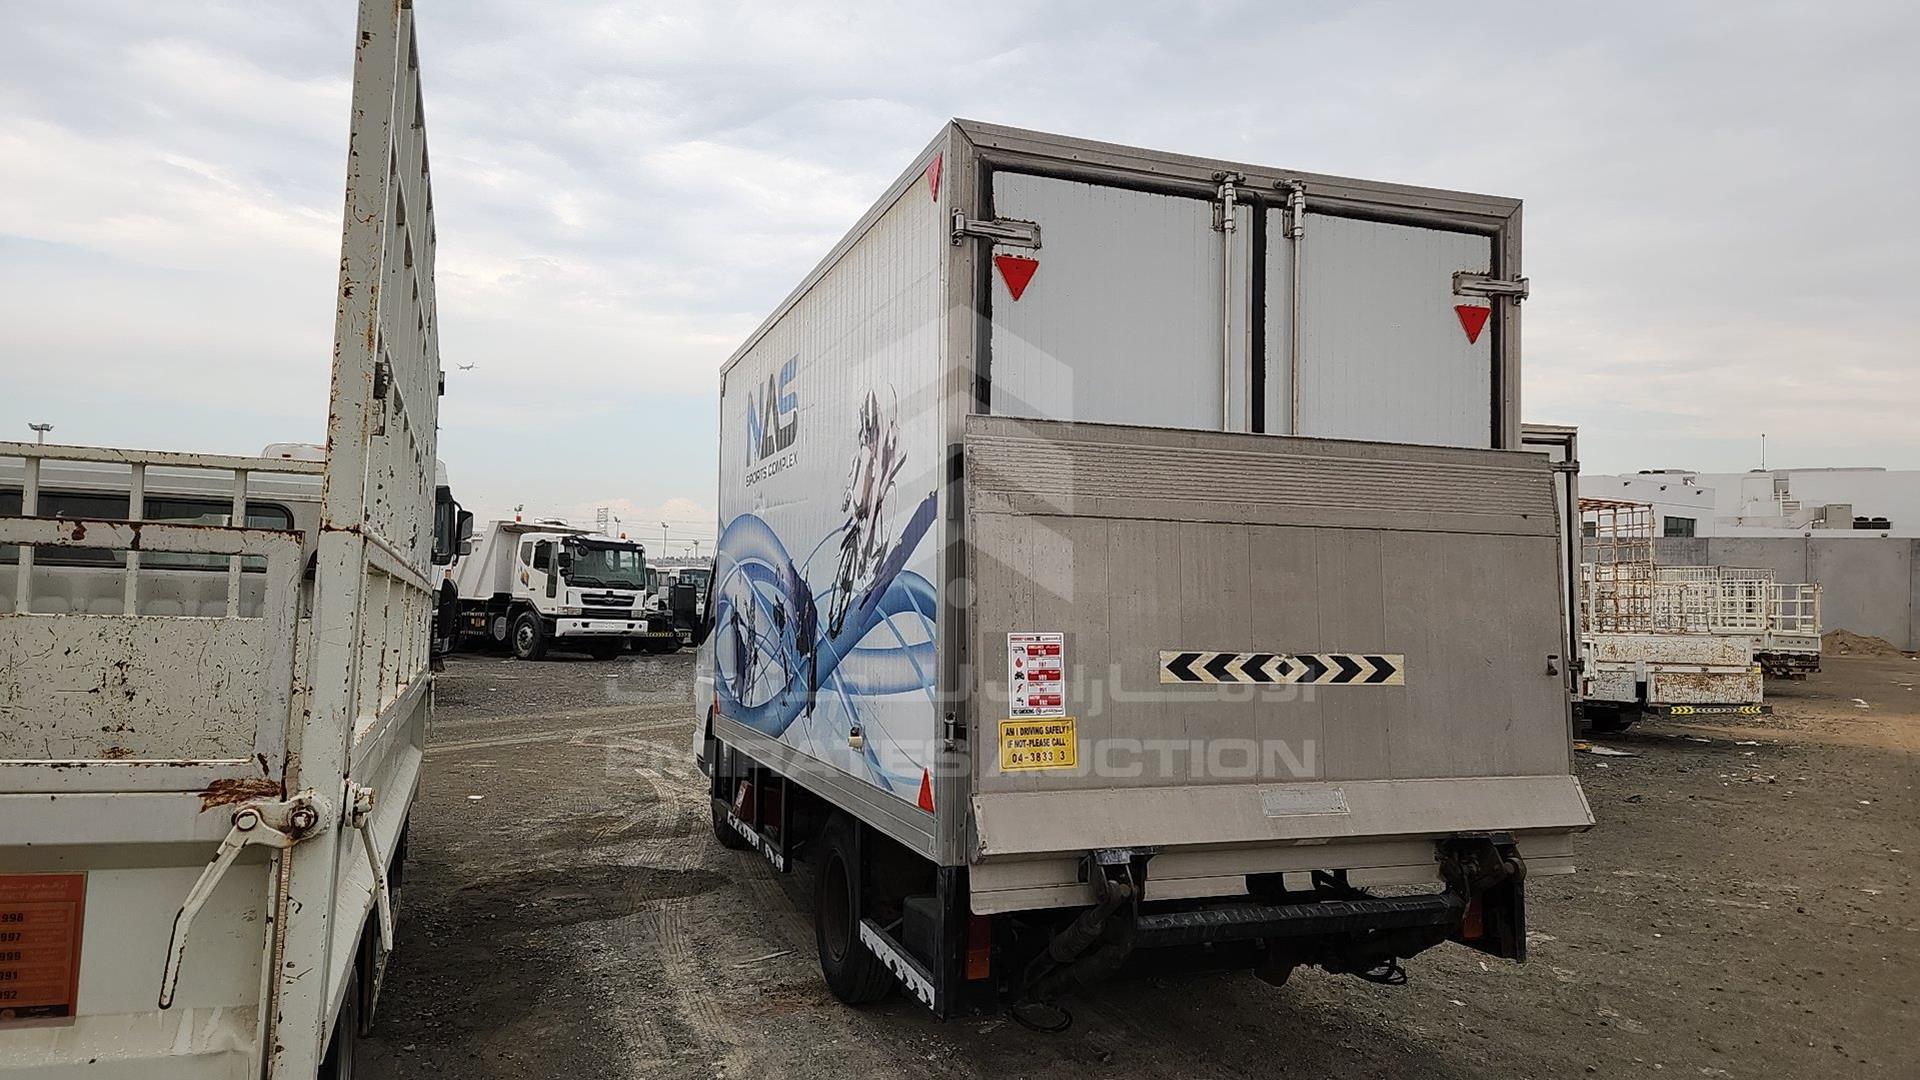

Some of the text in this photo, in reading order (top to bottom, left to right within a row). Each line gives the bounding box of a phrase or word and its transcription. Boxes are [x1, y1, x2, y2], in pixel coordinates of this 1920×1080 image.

[746, 353, 799, 468] NAS
[746, 451, 798, 487] SPORTS COMPLEX
[1006, 727, 1014, 736] AM
[1020, 726, 1043, 736] DRIVING
[1007, 740, 1013, 748] IF
